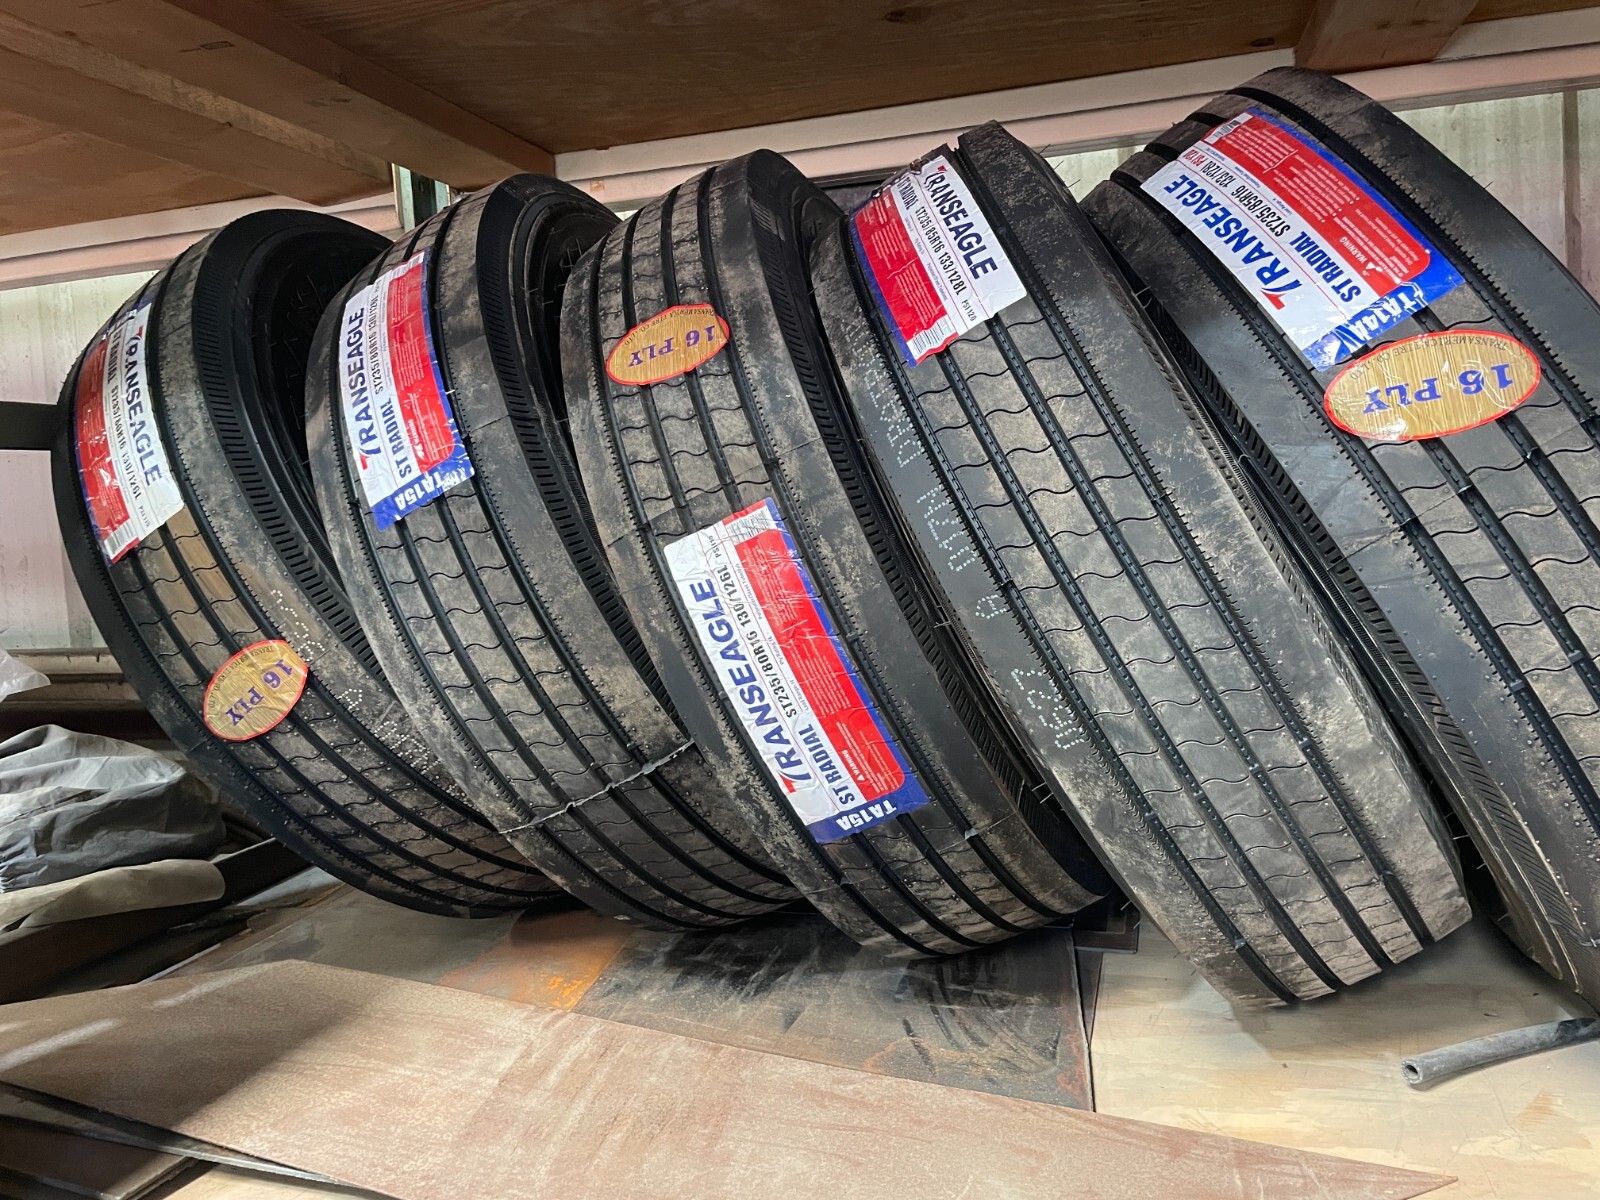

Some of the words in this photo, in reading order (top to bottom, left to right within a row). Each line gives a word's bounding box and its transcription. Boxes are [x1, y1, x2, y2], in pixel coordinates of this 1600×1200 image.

[922, 164, 998, 280] TRANSEAGLE
[1231, 183, 1291, 239] ST235/85R16
[913, 206, 945, 254] ST235/85R16
[936, 251, 966, 295] 133/128L
[1163, 172, 1302, 311] TRANSEAGLE
[1289, 230, 1343, 285] RADIAL
[1339, 235, 1367, 265] WARNING
[1331, 274, 1362, 303] ST
[627, 336, 674, 368] PLY
[683, 324, 718, 348] 16
[348, 307, 382, 470] TRANSEAGLE
[1362, 376, 1441, 414] PLY
[1456, 362, 1514, 396] 16
[379, 396, 406, 451] RADIAL
[394, 456, 413, 478] ST
[715, 564, 753, 627] 130/126L
[971, 589, 1008, 625] A
[261, 658, 294, 688] 16
[688, 576, 812, 794] TRANSEAGLE
[746, 629, 798, 718] ST235/80R16
[224, 685, 264, 726] PLY
[797, 722, 842, 785] RADIAL
[841, 747, 860, 776] WARNING
[830, 781, 856, 808] ST
[835, 798, 897, 831] TA15A
